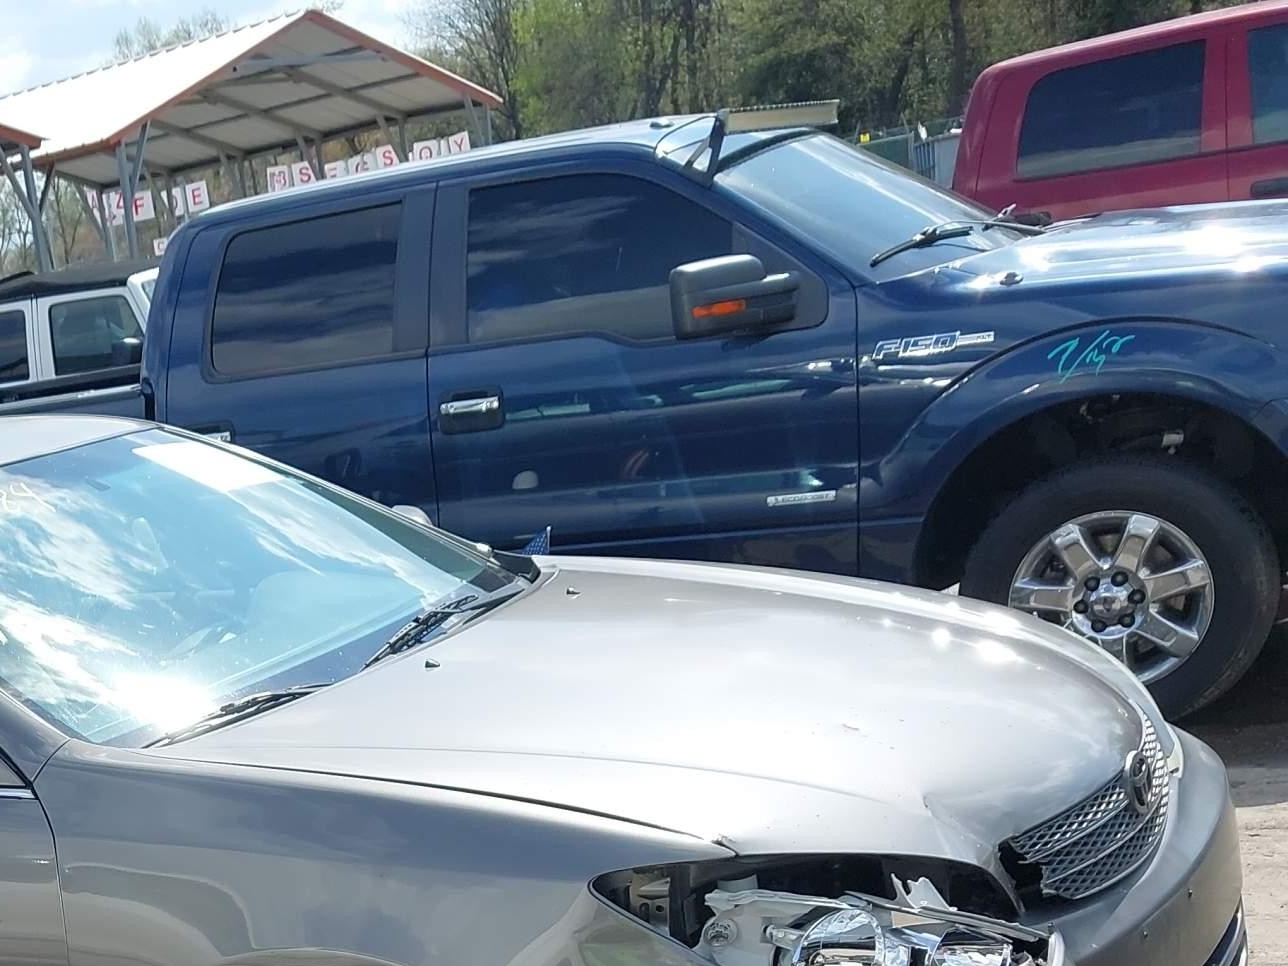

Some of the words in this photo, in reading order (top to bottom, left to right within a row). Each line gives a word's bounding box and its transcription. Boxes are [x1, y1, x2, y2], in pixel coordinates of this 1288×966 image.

[382, 149, 394, 166] S
[299, 166, 312, 184] S
[191, 187, 203, 206] E
[134, 196, 145, 216] F
